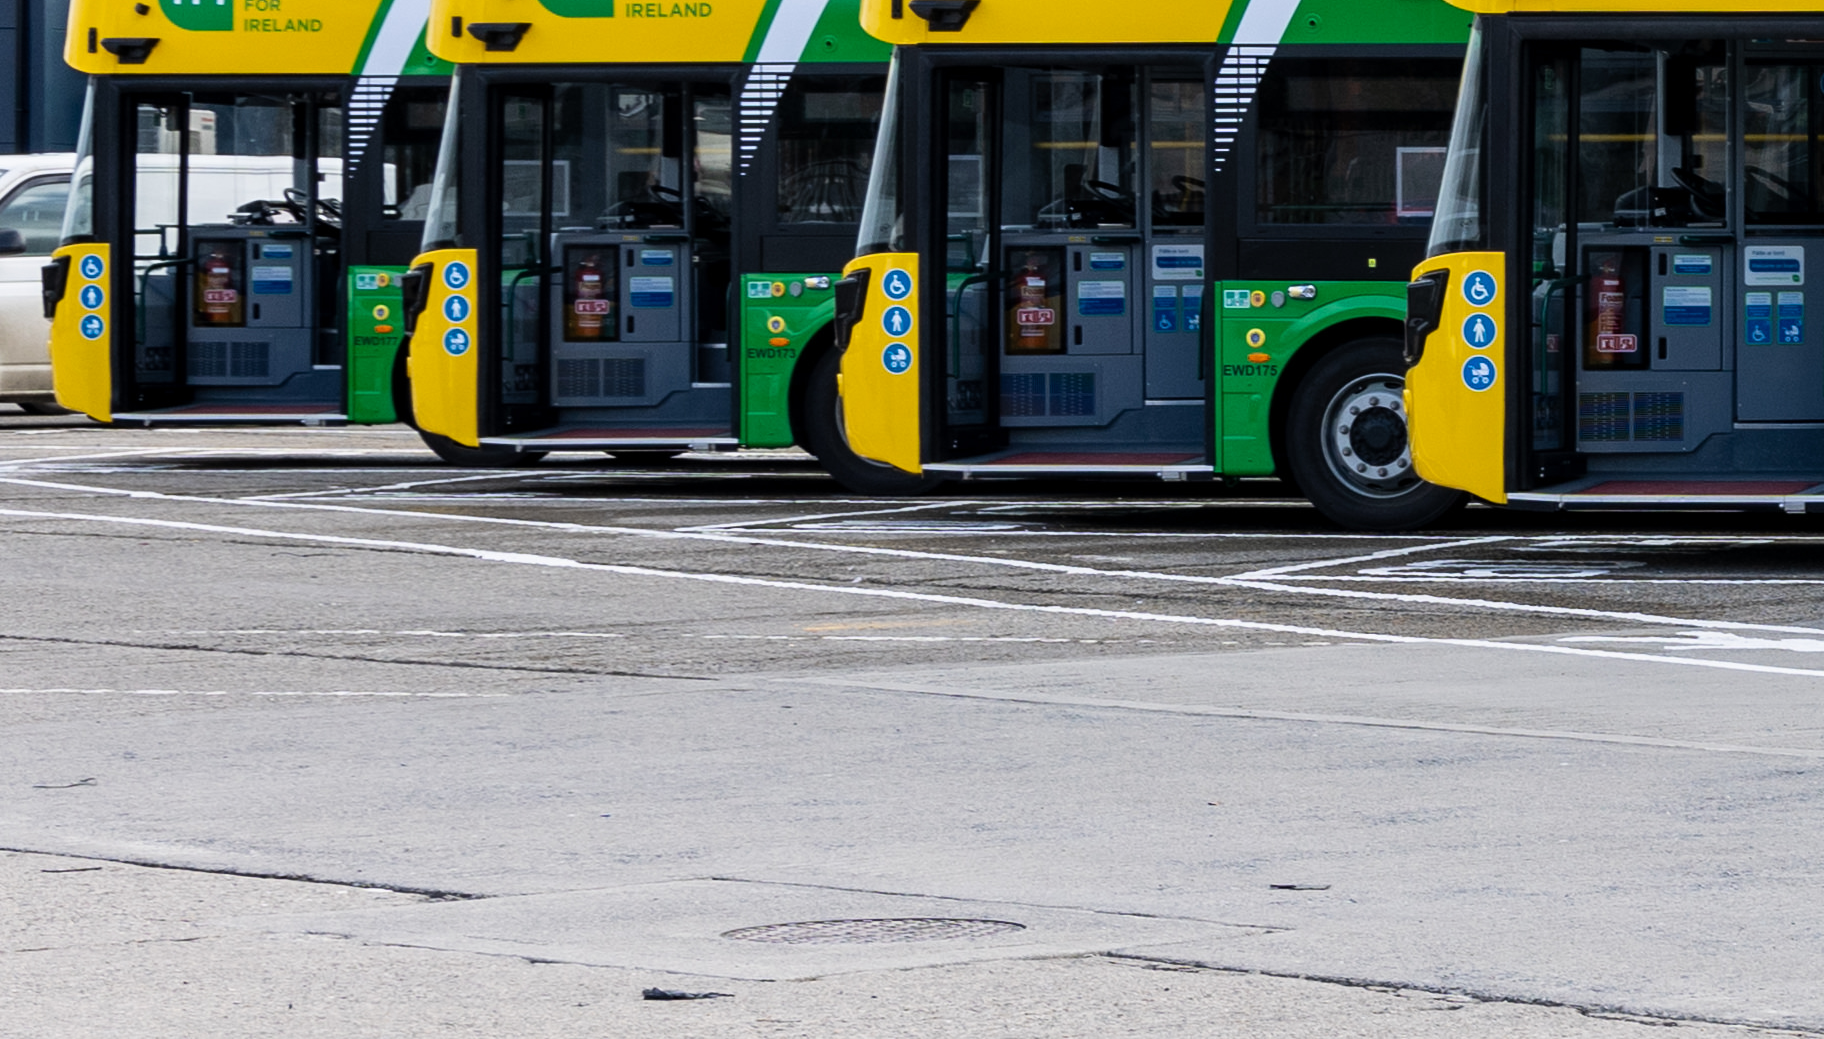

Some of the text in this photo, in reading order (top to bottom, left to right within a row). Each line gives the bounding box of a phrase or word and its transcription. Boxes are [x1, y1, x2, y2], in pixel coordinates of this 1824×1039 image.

[626, 3, 711, 17] IRELAND
[245, 19, 322, 32] IRELAND
[747, 348, 797, 359] EWD173
[1223, 364, 1278, 376] EWD175
